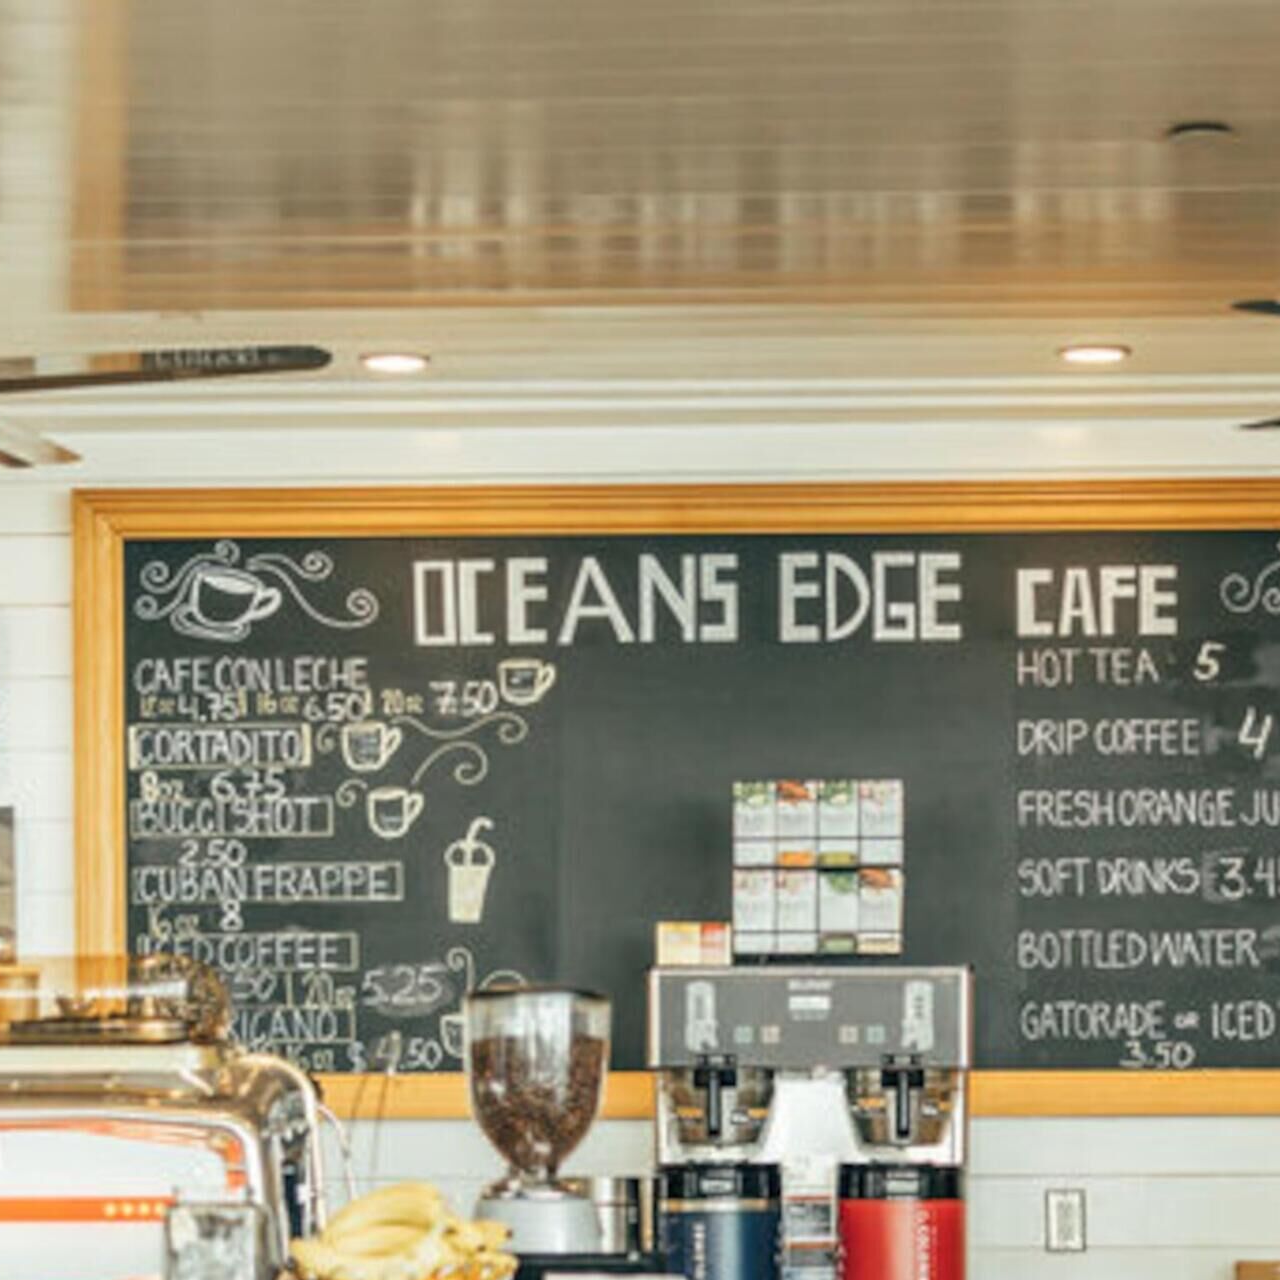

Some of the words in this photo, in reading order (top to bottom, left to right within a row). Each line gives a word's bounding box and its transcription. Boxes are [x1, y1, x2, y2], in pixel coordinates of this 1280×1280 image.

[412, 553, 739, 646] OCEANS
[778, 551, 963, 644] EDGE
[1015, 564, 1178, 638] CAFE
[134, 658, 212, 694] CAFE
[214, 658, 271, 696] CON
[278, 657, 368, 693] LECHE
[1017, 648, 1084, 687] HOT
[1090, 648, 1160, 686] TEA
[1193, 642, 1226, 681] 5
[177, 692, 238, 722] 4.75
[303, 692, 366, 722] 6.50
[429, 681, 498, 717] 7.50
[136, 729, 301, 766] CORTADITO
[1017, 719, 1089, 757] DRIP
[1093, 718, 1200, 756] COFFEE
[1237, 705, 1273, 760] 4
[231, 797, 318, 834] SHOT
[1017, 789, 1114, 828] FRESH
[1119, 788, 1236, 827] ORANGE
[177, 838, 248, 867] 2.50
[138, 867, 248, 901] CUBAN
[256, 866, 388, 900] FRAPPE
[1018, 857, 1090, 898] SOFT
[1096, 857, 1200, 896] DRINKS
[219, 898, 244, 931] 8
[219, 936, 339, 970] COFFEE
[1017, 930, 1148, 970] BOTTLED
[1150, 929, 1260, 969] WATER
[361, 965, 445, 1005] 5.25
[1020, 1000, 1166, 1042] GATORADE
[1211, 1001, 1274, 1041] ICED
[1121, 1041, 1195, 1069] 3.50
